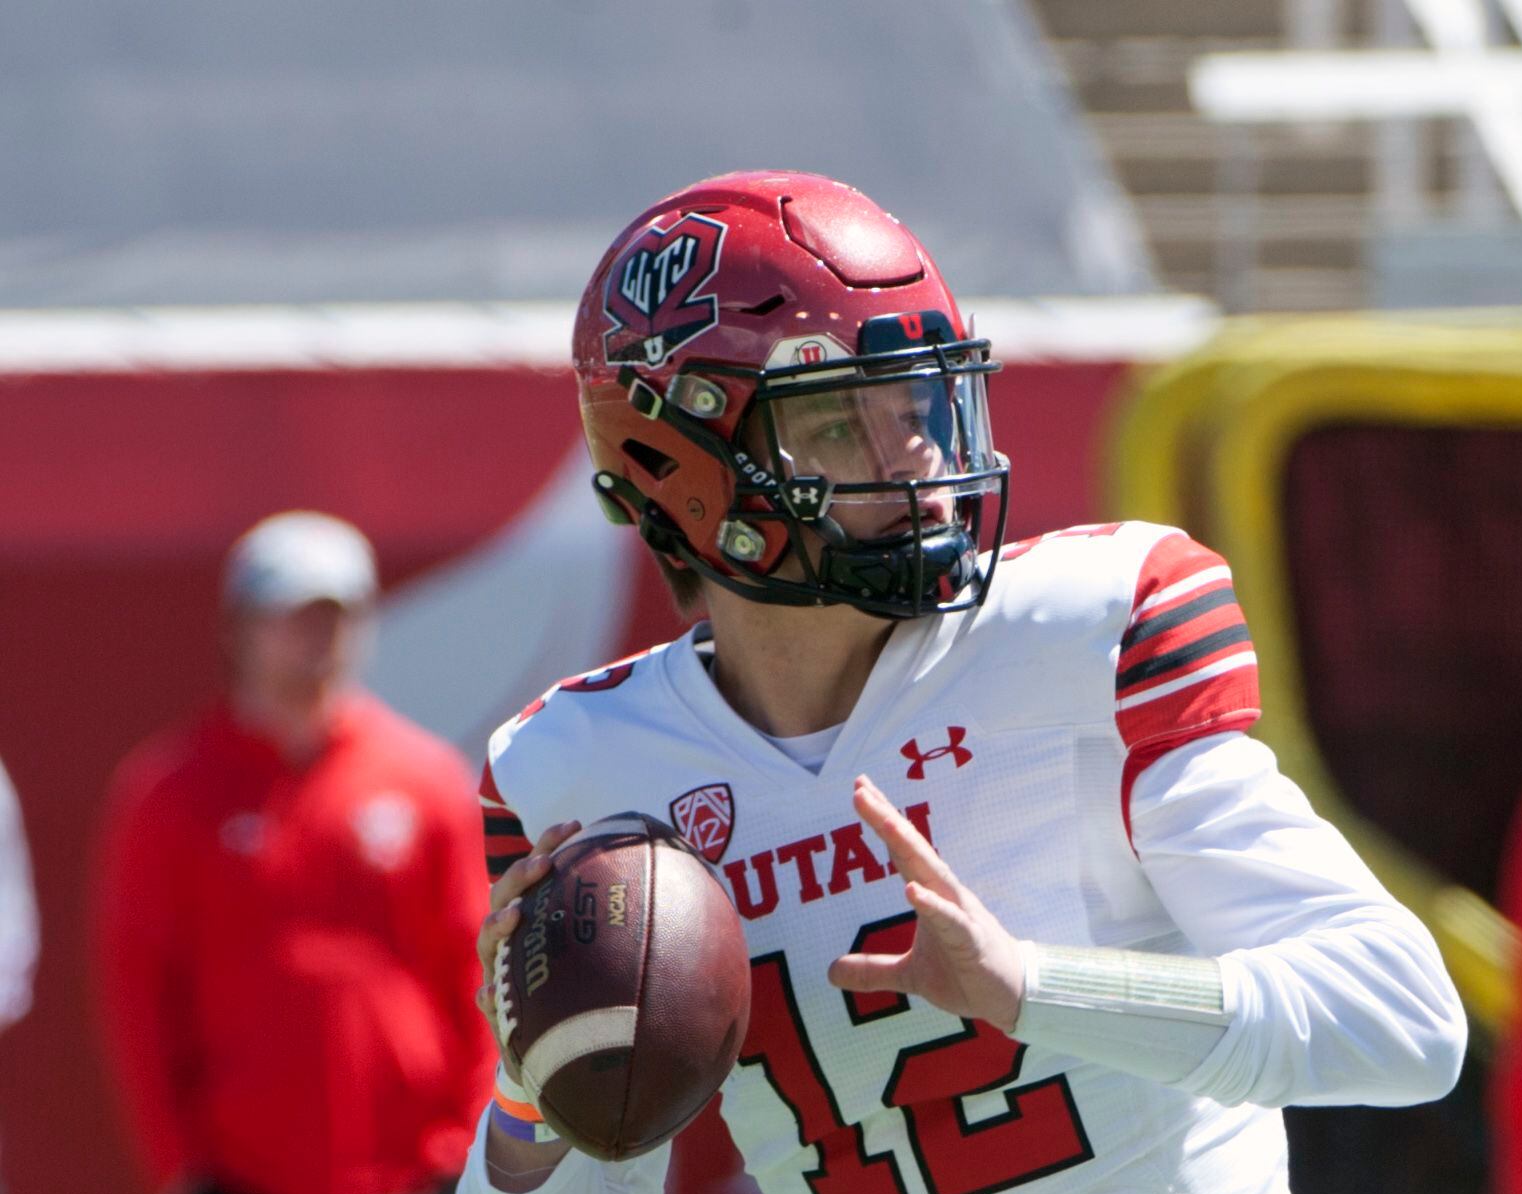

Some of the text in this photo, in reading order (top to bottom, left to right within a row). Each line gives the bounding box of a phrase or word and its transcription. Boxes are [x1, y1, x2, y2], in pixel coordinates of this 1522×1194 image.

[898, 313, 923, 340] U
[643, 335, 665, 363] U
[673, 786, 732, 840] PAC
[694, 816, 727, 851] 12
[574, 875, 599, 945] GST
[608, 883, 627, 927] NCAA
[524, 880, 554, 997] Wilson
